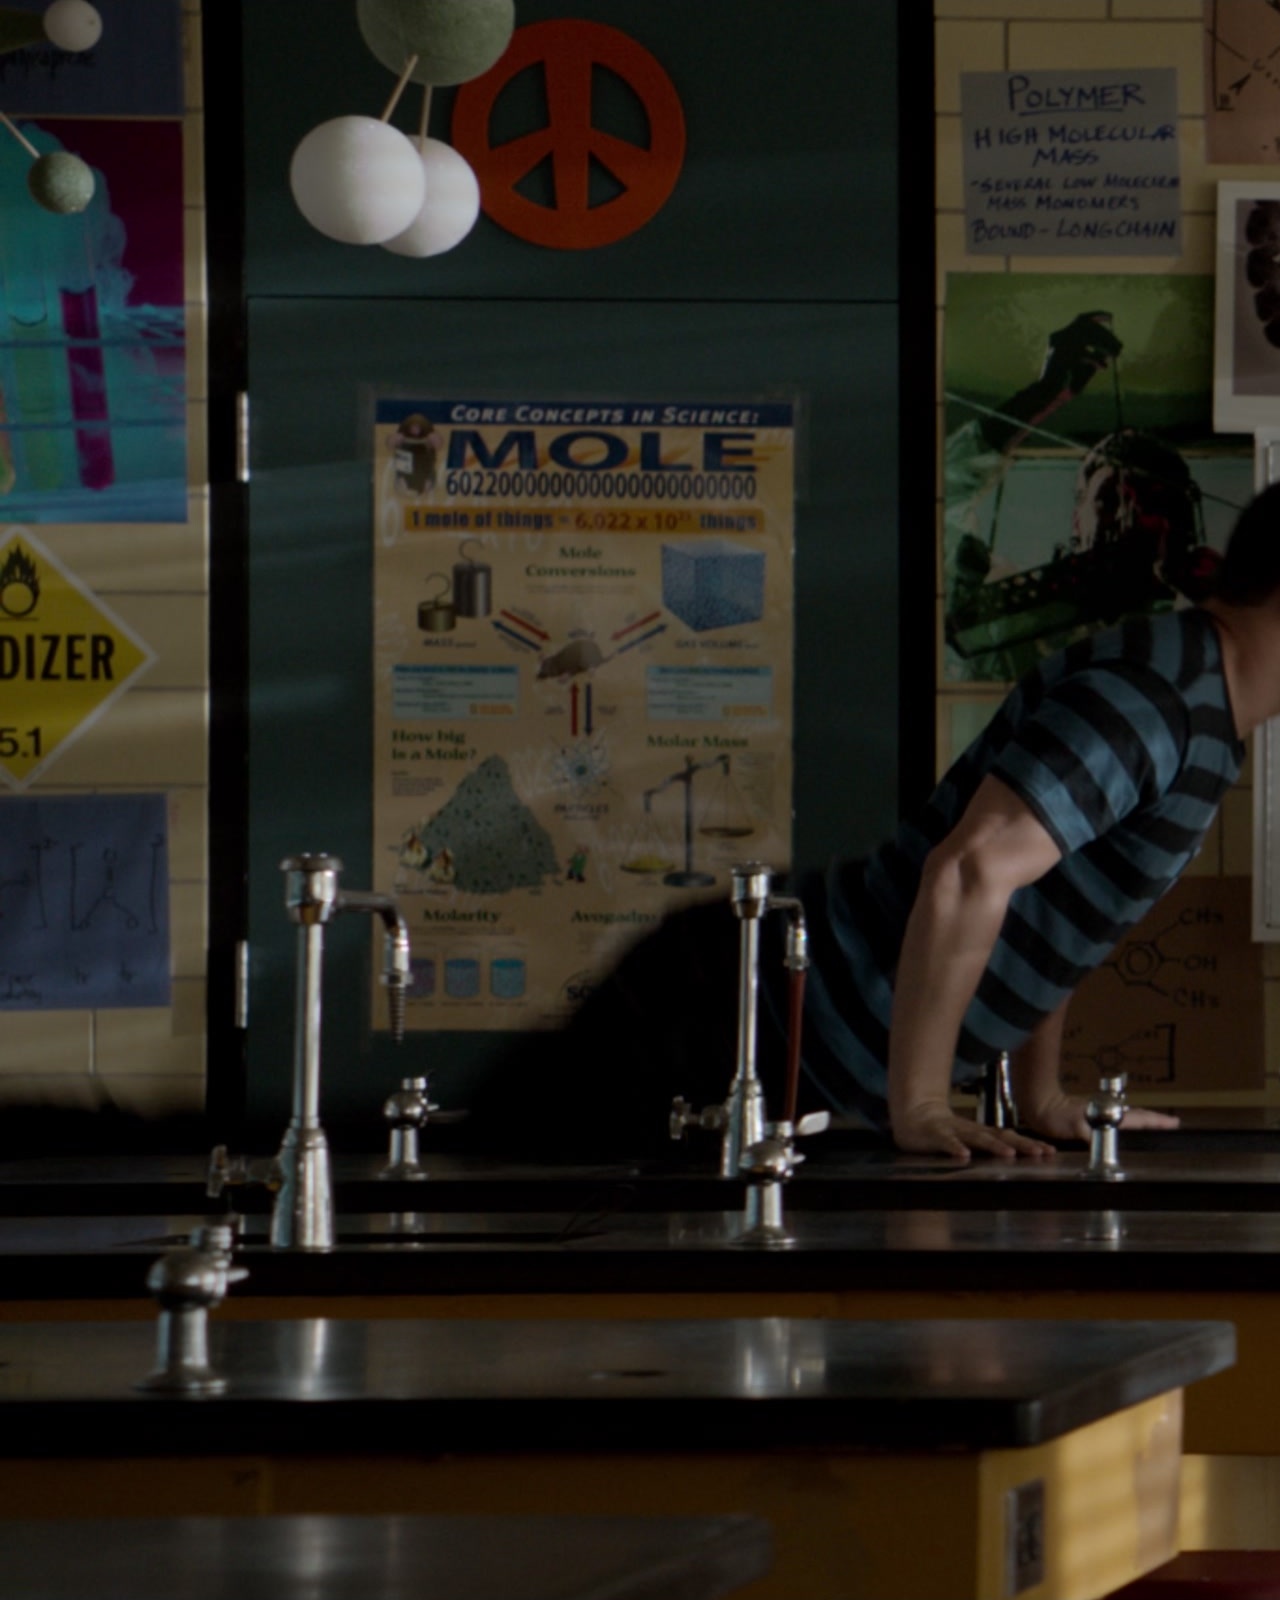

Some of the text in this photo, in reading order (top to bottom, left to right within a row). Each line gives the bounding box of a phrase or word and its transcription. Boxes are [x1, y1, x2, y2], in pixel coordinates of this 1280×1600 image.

[1008, 75, 1145, 111] POLYMER
[975, 124, 1176, 149] HIGH MOLECULAR
[1032, 147, 1099, 167] MASS
[1063, 177, 1098, 190] LOW
[987, 197, 1027, 212] MASS
[451, 404, 759, 425] CORE CONCEPTS IN SCIENCE:
[447, 430, 756, 472] MOLE
[413, 511, 419, 526] 1
[426, 511, 470, 527] mole
[475, 512, 493, 527] of
[497, 511, 553, 529] things
[575, 511, 631, 529] 6.022
[701, 513, 757, 531] things
[560, 546, 602, 560] Mole
[526, 563, 636, 577] Conversions
[0, 634, 114, 681] DIZER
[0, 727, 42, 757] 5.1
[392, 730, 433, 742] How
[648, 734, 749, 747] Molar Mass
[424, 909, 501, 922] Molarity
